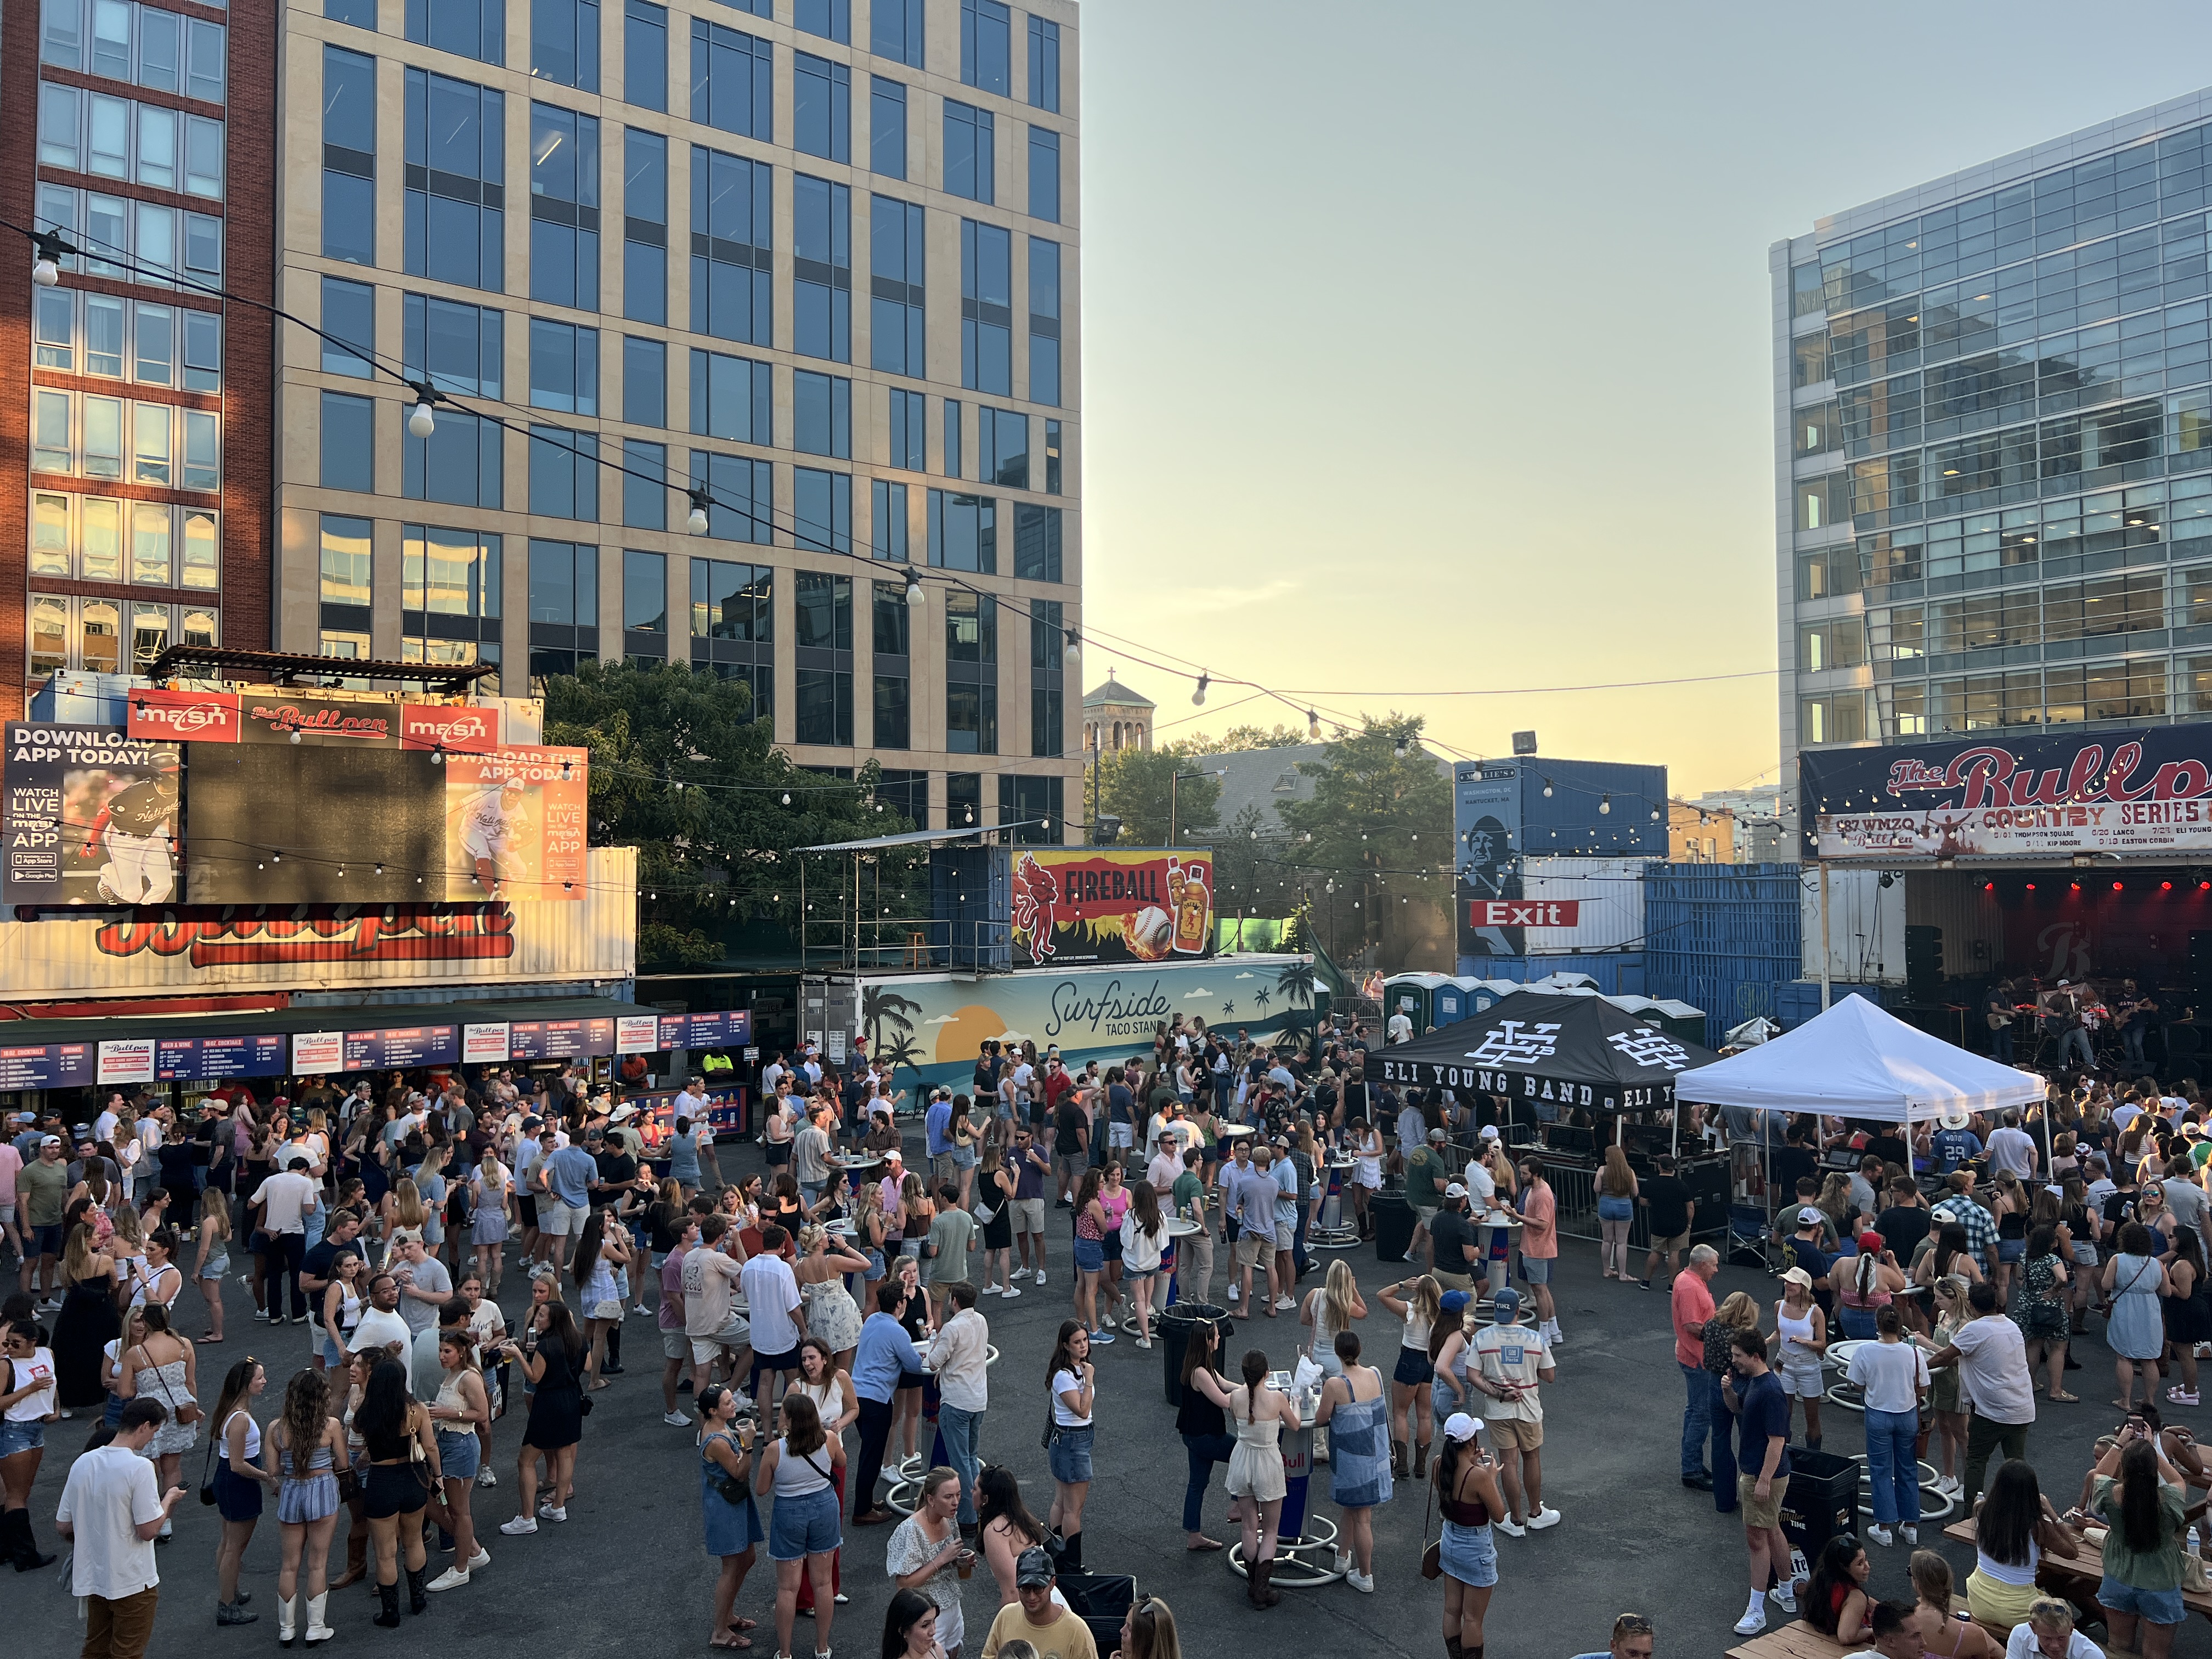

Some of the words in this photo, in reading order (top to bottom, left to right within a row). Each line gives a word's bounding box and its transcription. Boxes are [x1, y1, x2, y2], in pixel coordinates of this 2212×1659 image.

[251, 706, 274, 719] The
[270, 704, 388, 732] Bullpen
[14, 747, 61, 762] APP
[66, 748, 149, 765] TODAY!
[446, 752, 543, 765] OWNLOAD
[547, 754, 582, 767] THE
[479, 766, 515, 779] APP
[522, 768, 581, 781] TODAY!
[1466, 770, 1509, 780] MLIE'S
[1886, 758, 1947, 795] The
[1945, 741, 2212, 810] Bullp
[14, 788, 59, 797] WATCH
[1463, 788, 1502, 796] WASHINGTON,
[13, 798, 59, 812] LIVE
[548, 803, 580, 811] WATCH
[547, 812, 580, 823] LIVE
[1983, 806, 2105, 829] COUNTRY
[2121, 800, 2199, 825] SERIES
[1862, 817, 1915, 831] WMZQ
[13, 832, 59, 848] APP
[547, 841, 580, 853] APP
[1065, 870, 1160, 905] FIREBALL
[1486, 901, 1561, 926] Exit
[1045, 979, 1171, 1036] Surfside
[1105, 1023, 1130, 1036] TACO
[110, 1044, 149, 1052] Bullpen
[303, 1037, 337, 1045] Bullpen
[1384, 1062, 1418, 1082] ELI
[1432, 1065, 1507, 1093] YOUNG
[1524, 1076, 1592, 1106] BAND
[1624, 1087, 1652, 1107] ELI
[1944, 1146, 1966, 1161] 29
[1160, 1254, 1172, 1265] ed
[1282, 1452, 1305, 1468] Bull
[1779, 1511, 1806, 1523] Miller
[1791, 1519, 1806, 1530] TIME
